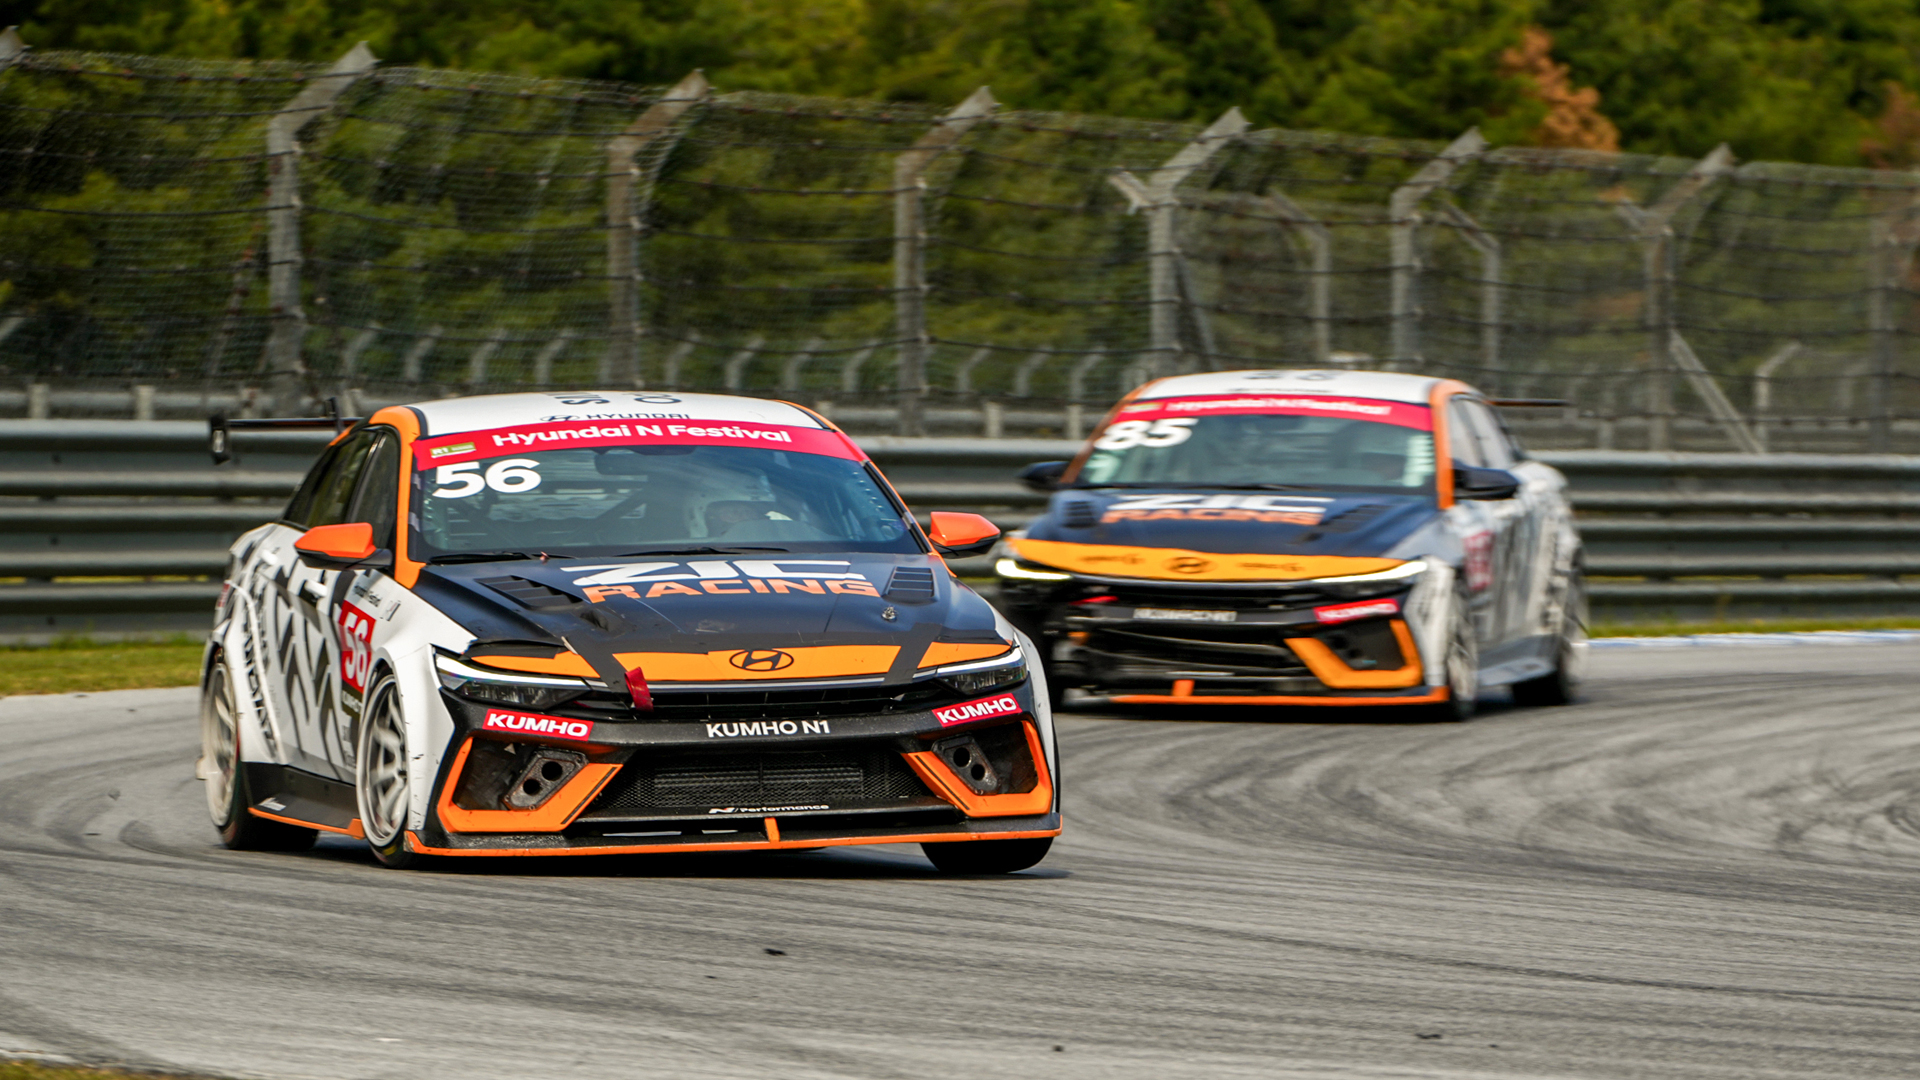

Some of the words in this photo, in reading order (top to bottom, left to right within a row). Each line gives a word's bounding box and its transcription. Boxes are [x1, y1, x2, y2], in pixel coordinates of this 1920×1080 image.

[492, 424, 628, 447] Hyundai
[635, 424, 663, 437] N
[670, 425, 792, 443] Festival
[1093, 418, 1199, 450] 85
[432, 458, 542, 499] 56
[1107, 494, 1336, 513] ZIC
[1100, 508, 1324, 525] RACING
[560, 560, 866, 587] ZIC
[582, 579, 881, 604] RACING
[344, 611, 369, 688] 56
[937, 697, 1017, 724] KUMHO
[487, 713, 588, 737] KUMHO
[706, 720, 798, 738] KUMHO
[801, 720, 830, 734] N1
[740, 804, 829, 813] Performance
